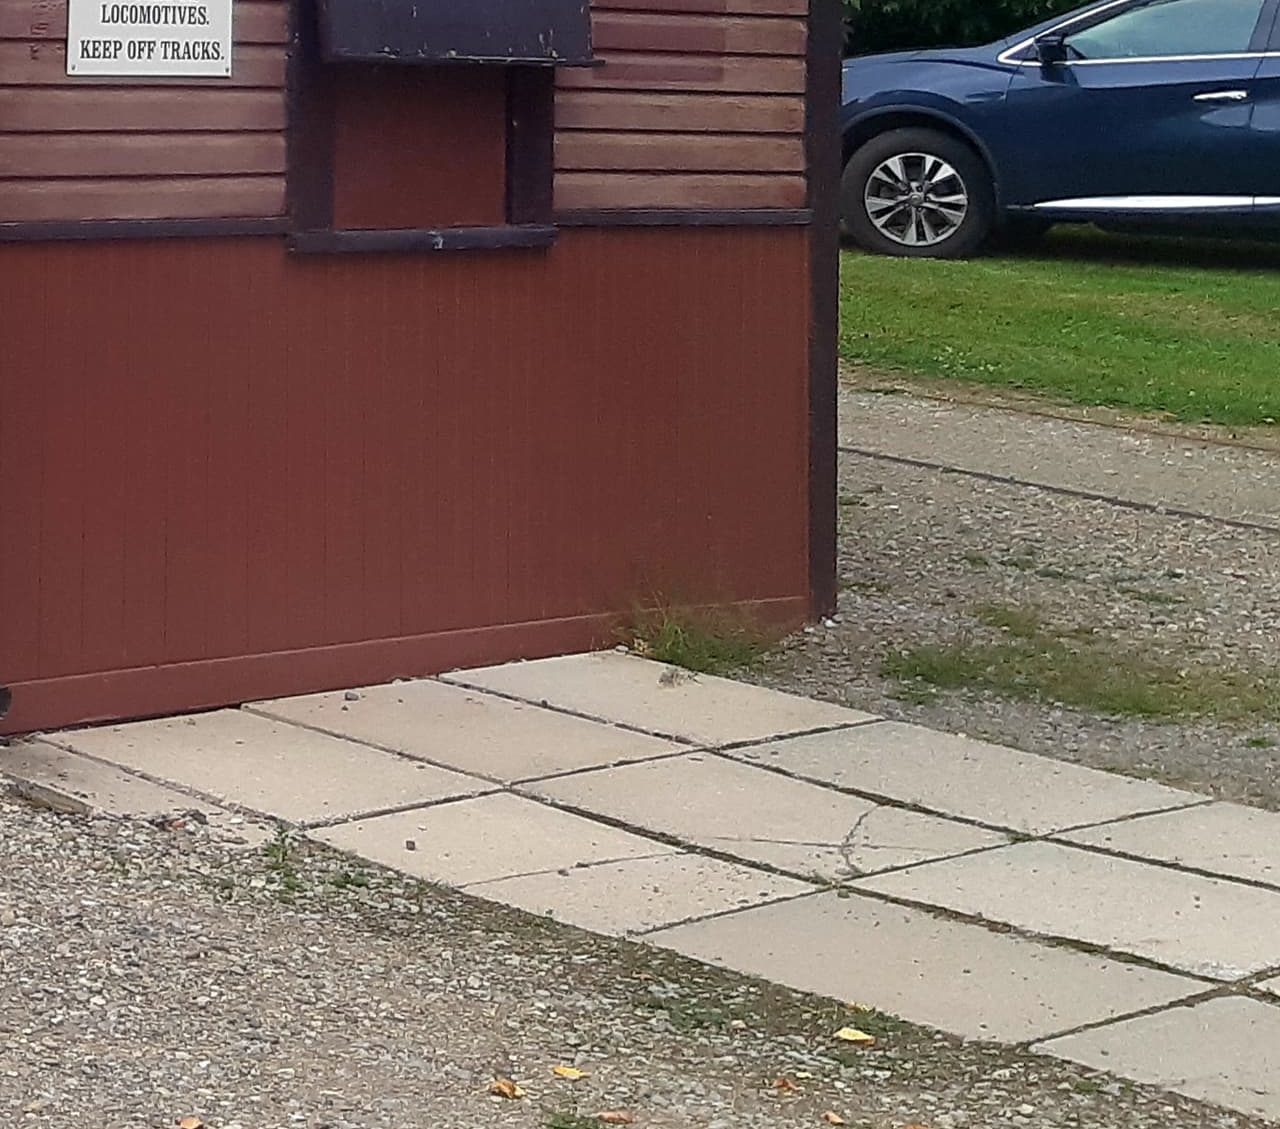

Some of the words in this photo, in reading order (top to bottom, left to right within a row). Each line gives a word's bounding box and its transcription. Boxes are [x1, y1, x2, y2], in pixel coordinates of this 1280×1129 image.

[101, 4, 210, 25] LOCOMOTIVES.
[80, 40, 122, 59] KEEP
[127, 40, 156, 60] OFF
[161, 41, 225, 60] TRACKS.
